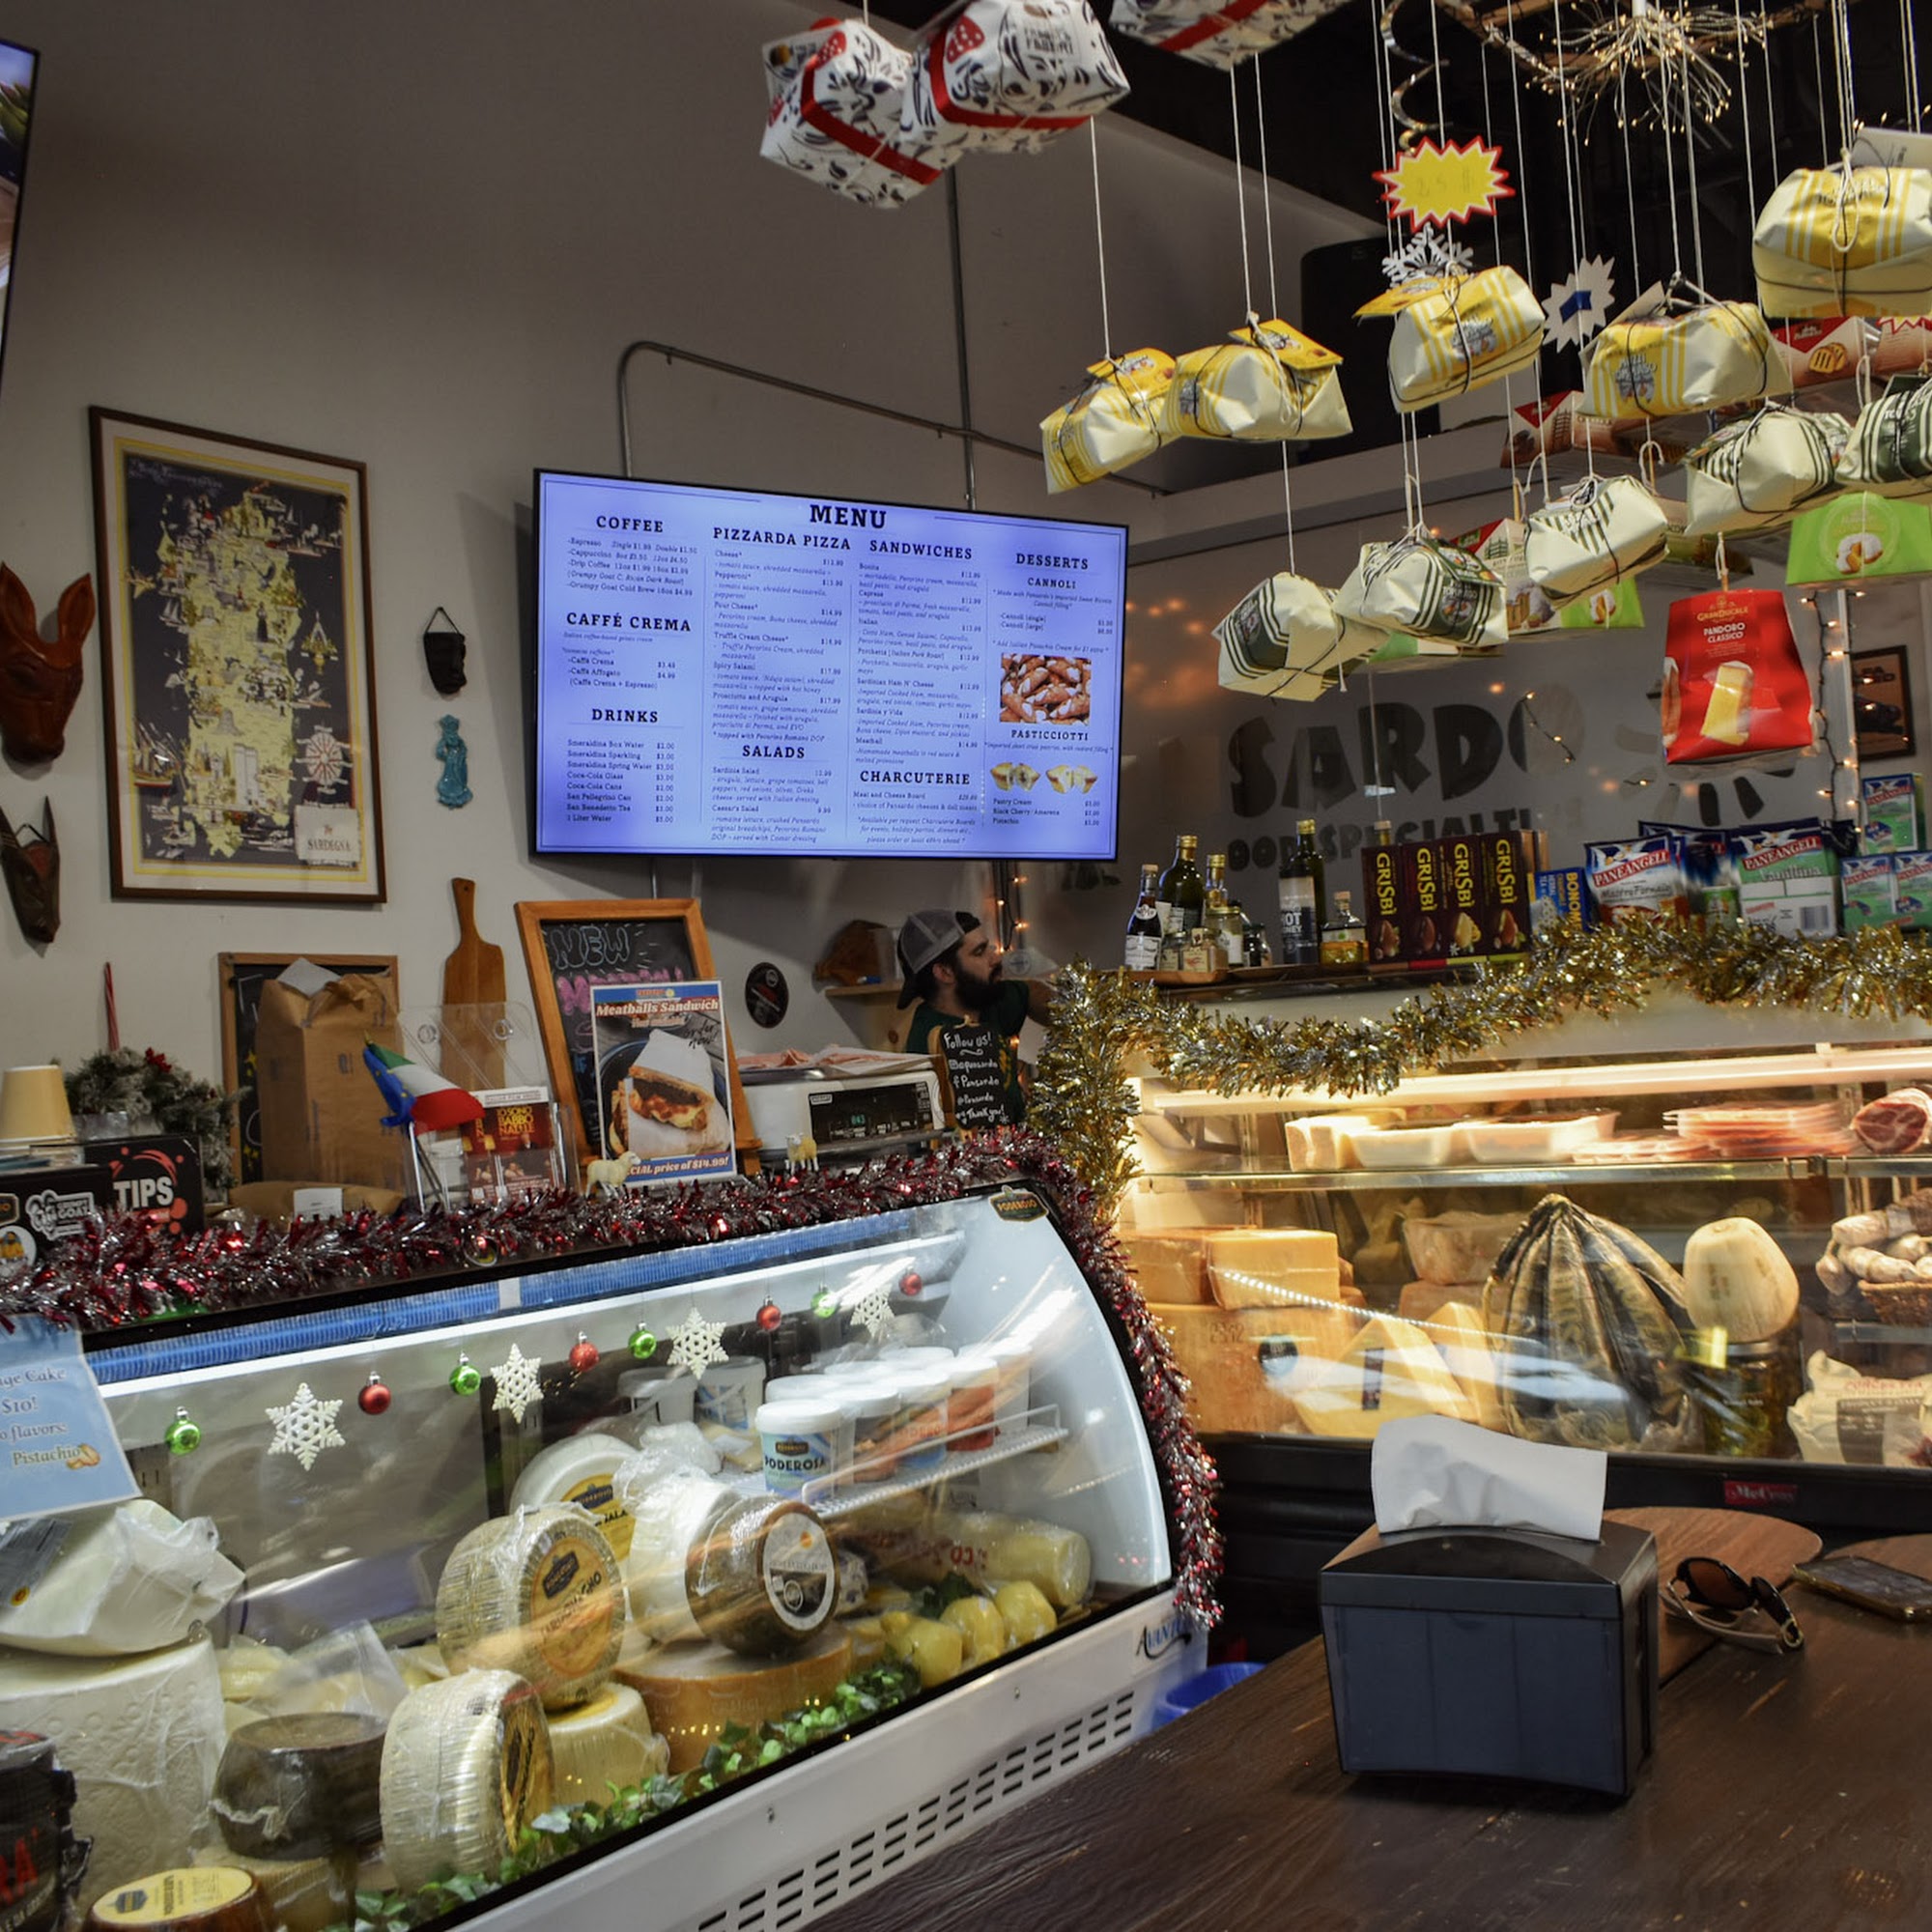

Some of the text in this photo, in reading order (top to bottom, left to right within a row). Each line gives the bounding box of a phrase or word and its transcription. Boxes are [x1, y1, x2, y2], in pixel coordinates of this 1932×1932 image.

[810, 503, 886, 529] MENU
[596, 515, 664, 533] COFFEE
[713, 526, 851, 550] PIZZARDA PIZZA
[869, 539, 973, 560] SANDWICHES
[587, 560, 611, 569] Coffee
[1015, 553, 1089, 570] DESSERTS
[1027, 577, 1077, 589] CANNOLI
[566, 612, 692, 632] CAFFÉ CREMA
[1704, 622, 1746, 636] PANDORO
[1707, 631, 1745, 643] CLASSICO
[591, 708, 659, 723] DRINKS
[1010, 729, 1089, 741] PASTICCIOTTI
[742, 745, 805, 759] SALADS
[566, 771, 603, 780] Coca-Cola
[860, 770, 971, 785] CHARCUTERIE
[566, 781, 603, 790] Coca-Cola
[566, 792, 581, 801] San
[566, 803, 581, 811] San
[590, 814, 611, 823] Water
[307, 838, 351, 851] SARDEGNA
[1744, 835, 1822, 870] PANEANGELI
[1594, 850, 1670, 888] PANEANGELI
[550, 925, 630, 970] NEW
[596, 999, 719, 1016] Meatballs Sandwich
[943, 1032, 974, 1049] Follow
[966, 1107, 988, 1120] Thank
[654, 1162, 679, 1175] price
[680, 1160, 692, 1170] of
[113, 1177, 174, 1212] TIPS
[25, 1368, 67, 1382] Cake
[13, 1445, 81, 1465] Pistachio
